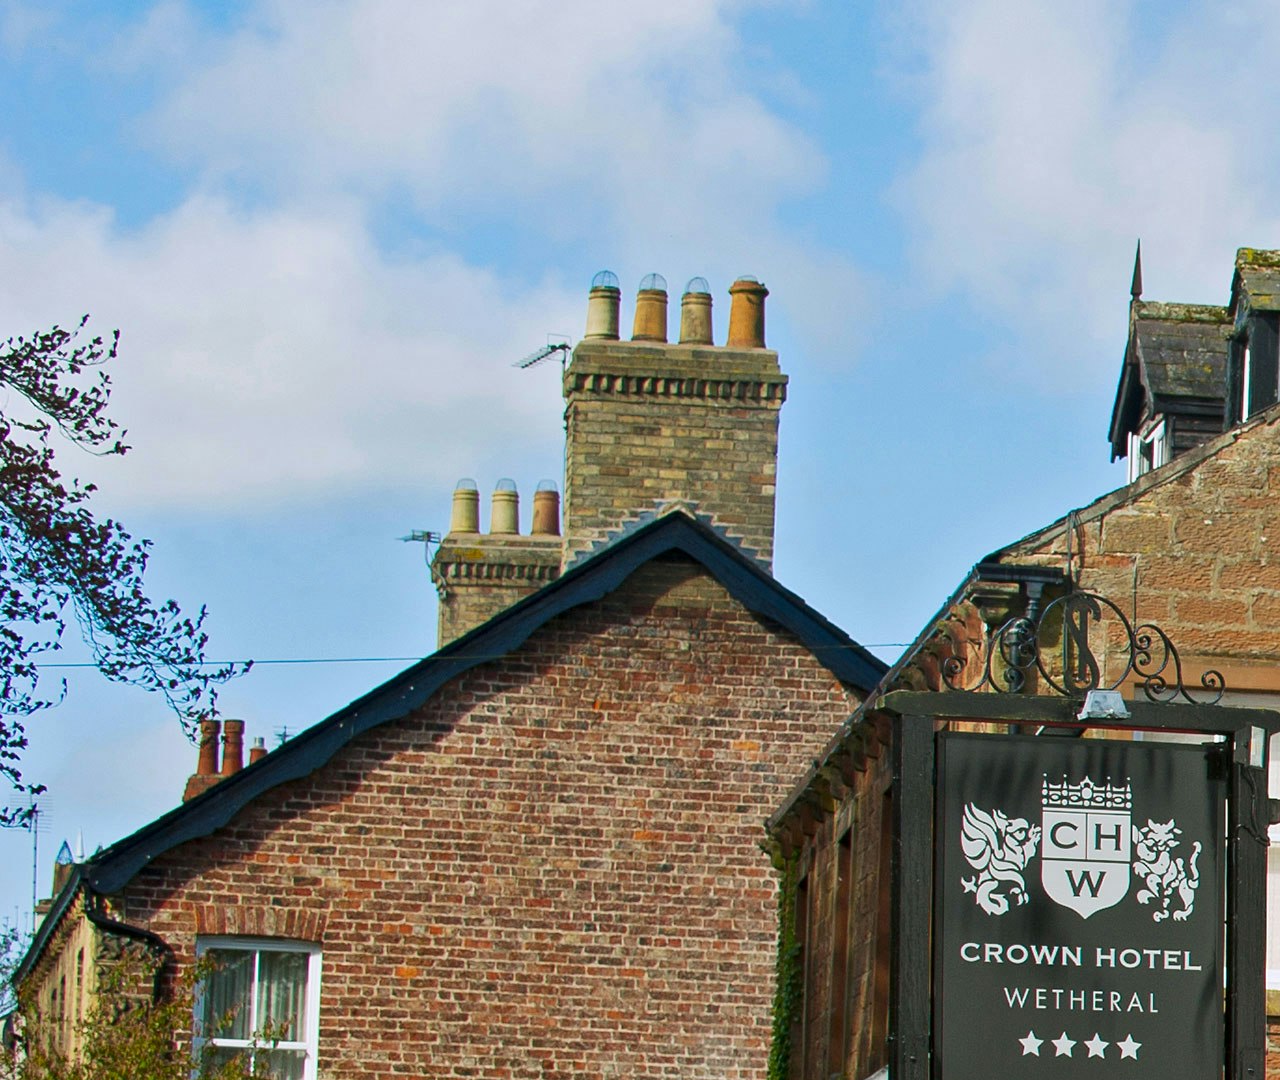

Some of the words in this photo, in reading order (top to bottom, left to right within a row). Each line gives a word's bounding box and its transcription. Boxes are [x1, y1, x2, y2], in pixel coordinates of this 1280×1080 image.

[1049, 821, 1078, 849] C
[1094, 823, 1122, 852] H
[1065, 870, 1107, 898] W
[959, 942, 1083, 967] CROWN
[1095, 947, 1202, 971] HOTEL
[1003, 987, 1159, 1014] WETHERAL
